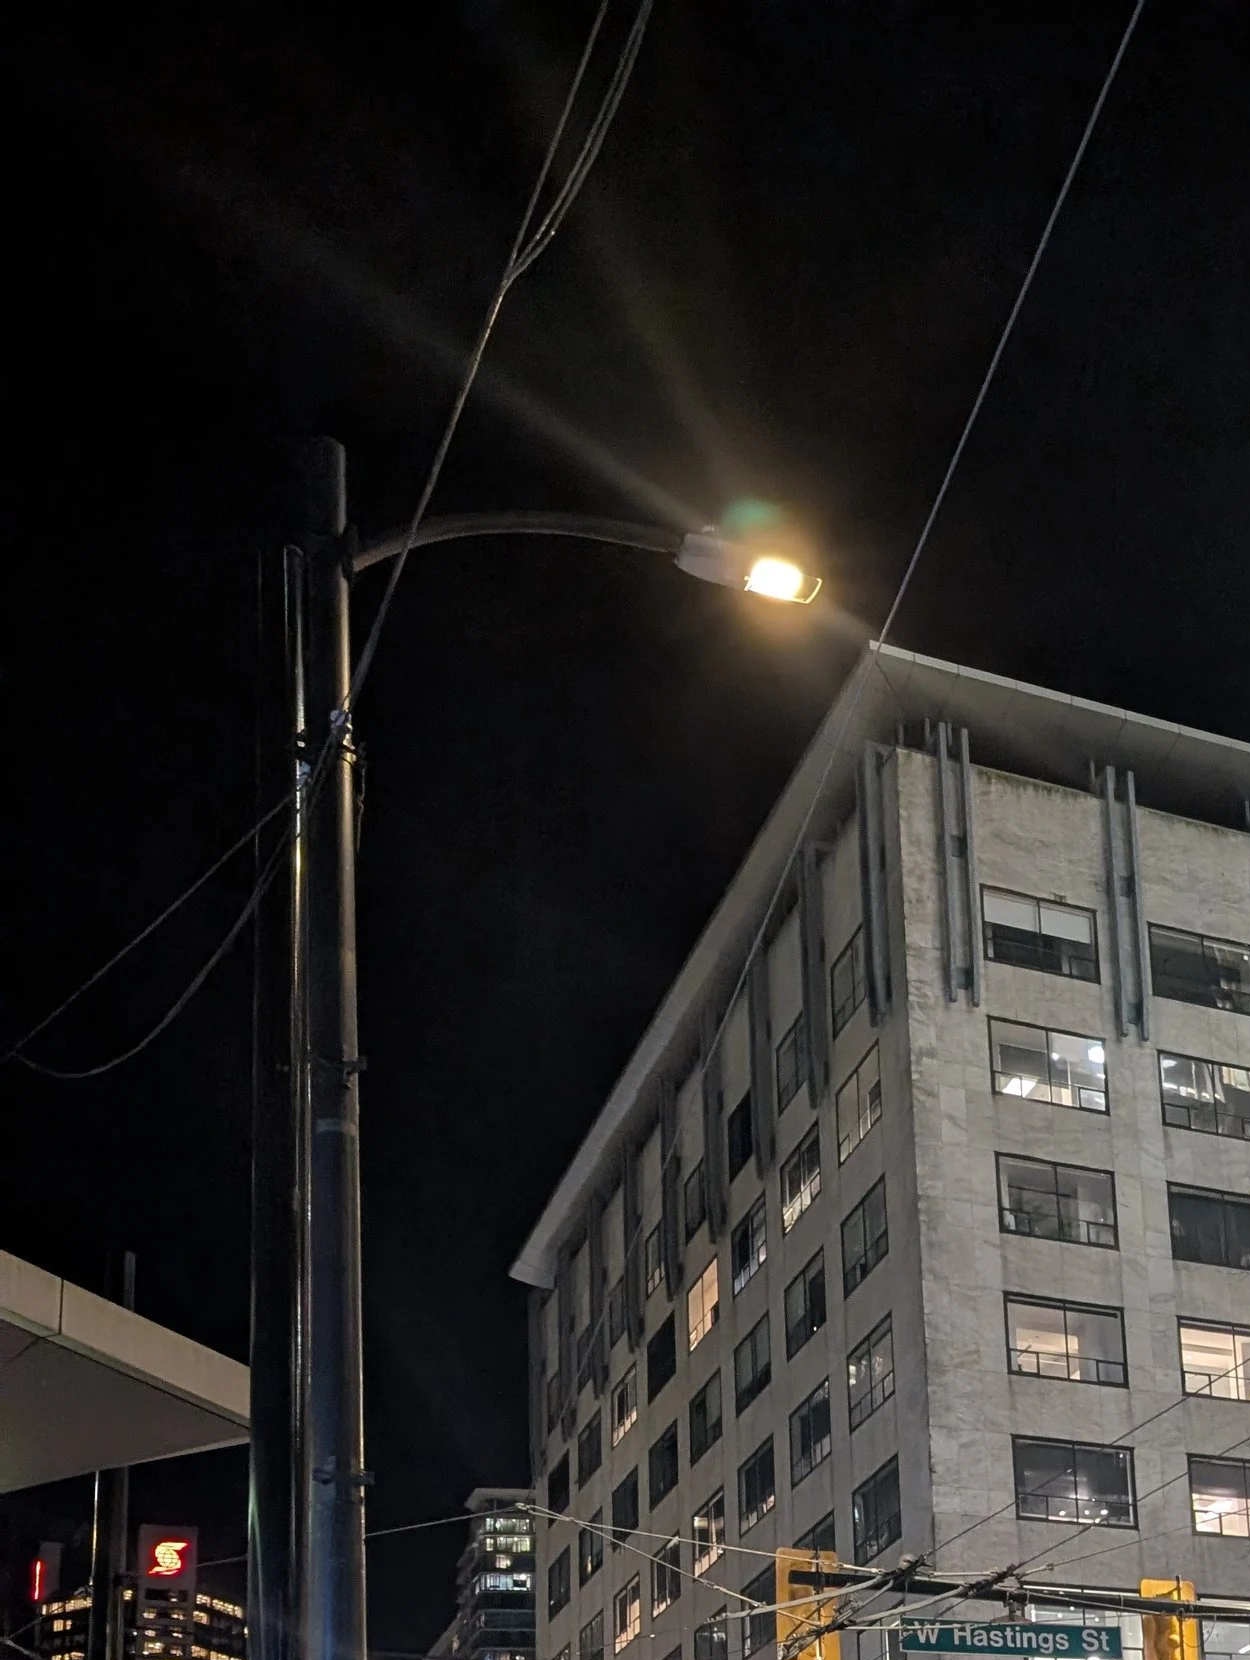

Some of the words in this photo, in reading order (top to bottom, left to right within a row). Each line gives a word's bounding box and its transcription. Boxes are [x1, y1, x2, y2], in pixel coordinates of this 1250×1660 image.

[916, 1621, 939, 1645] W
[953, 1624, 1069, 1654] Hastings
[1082, 1629, 1110, 1652] St
